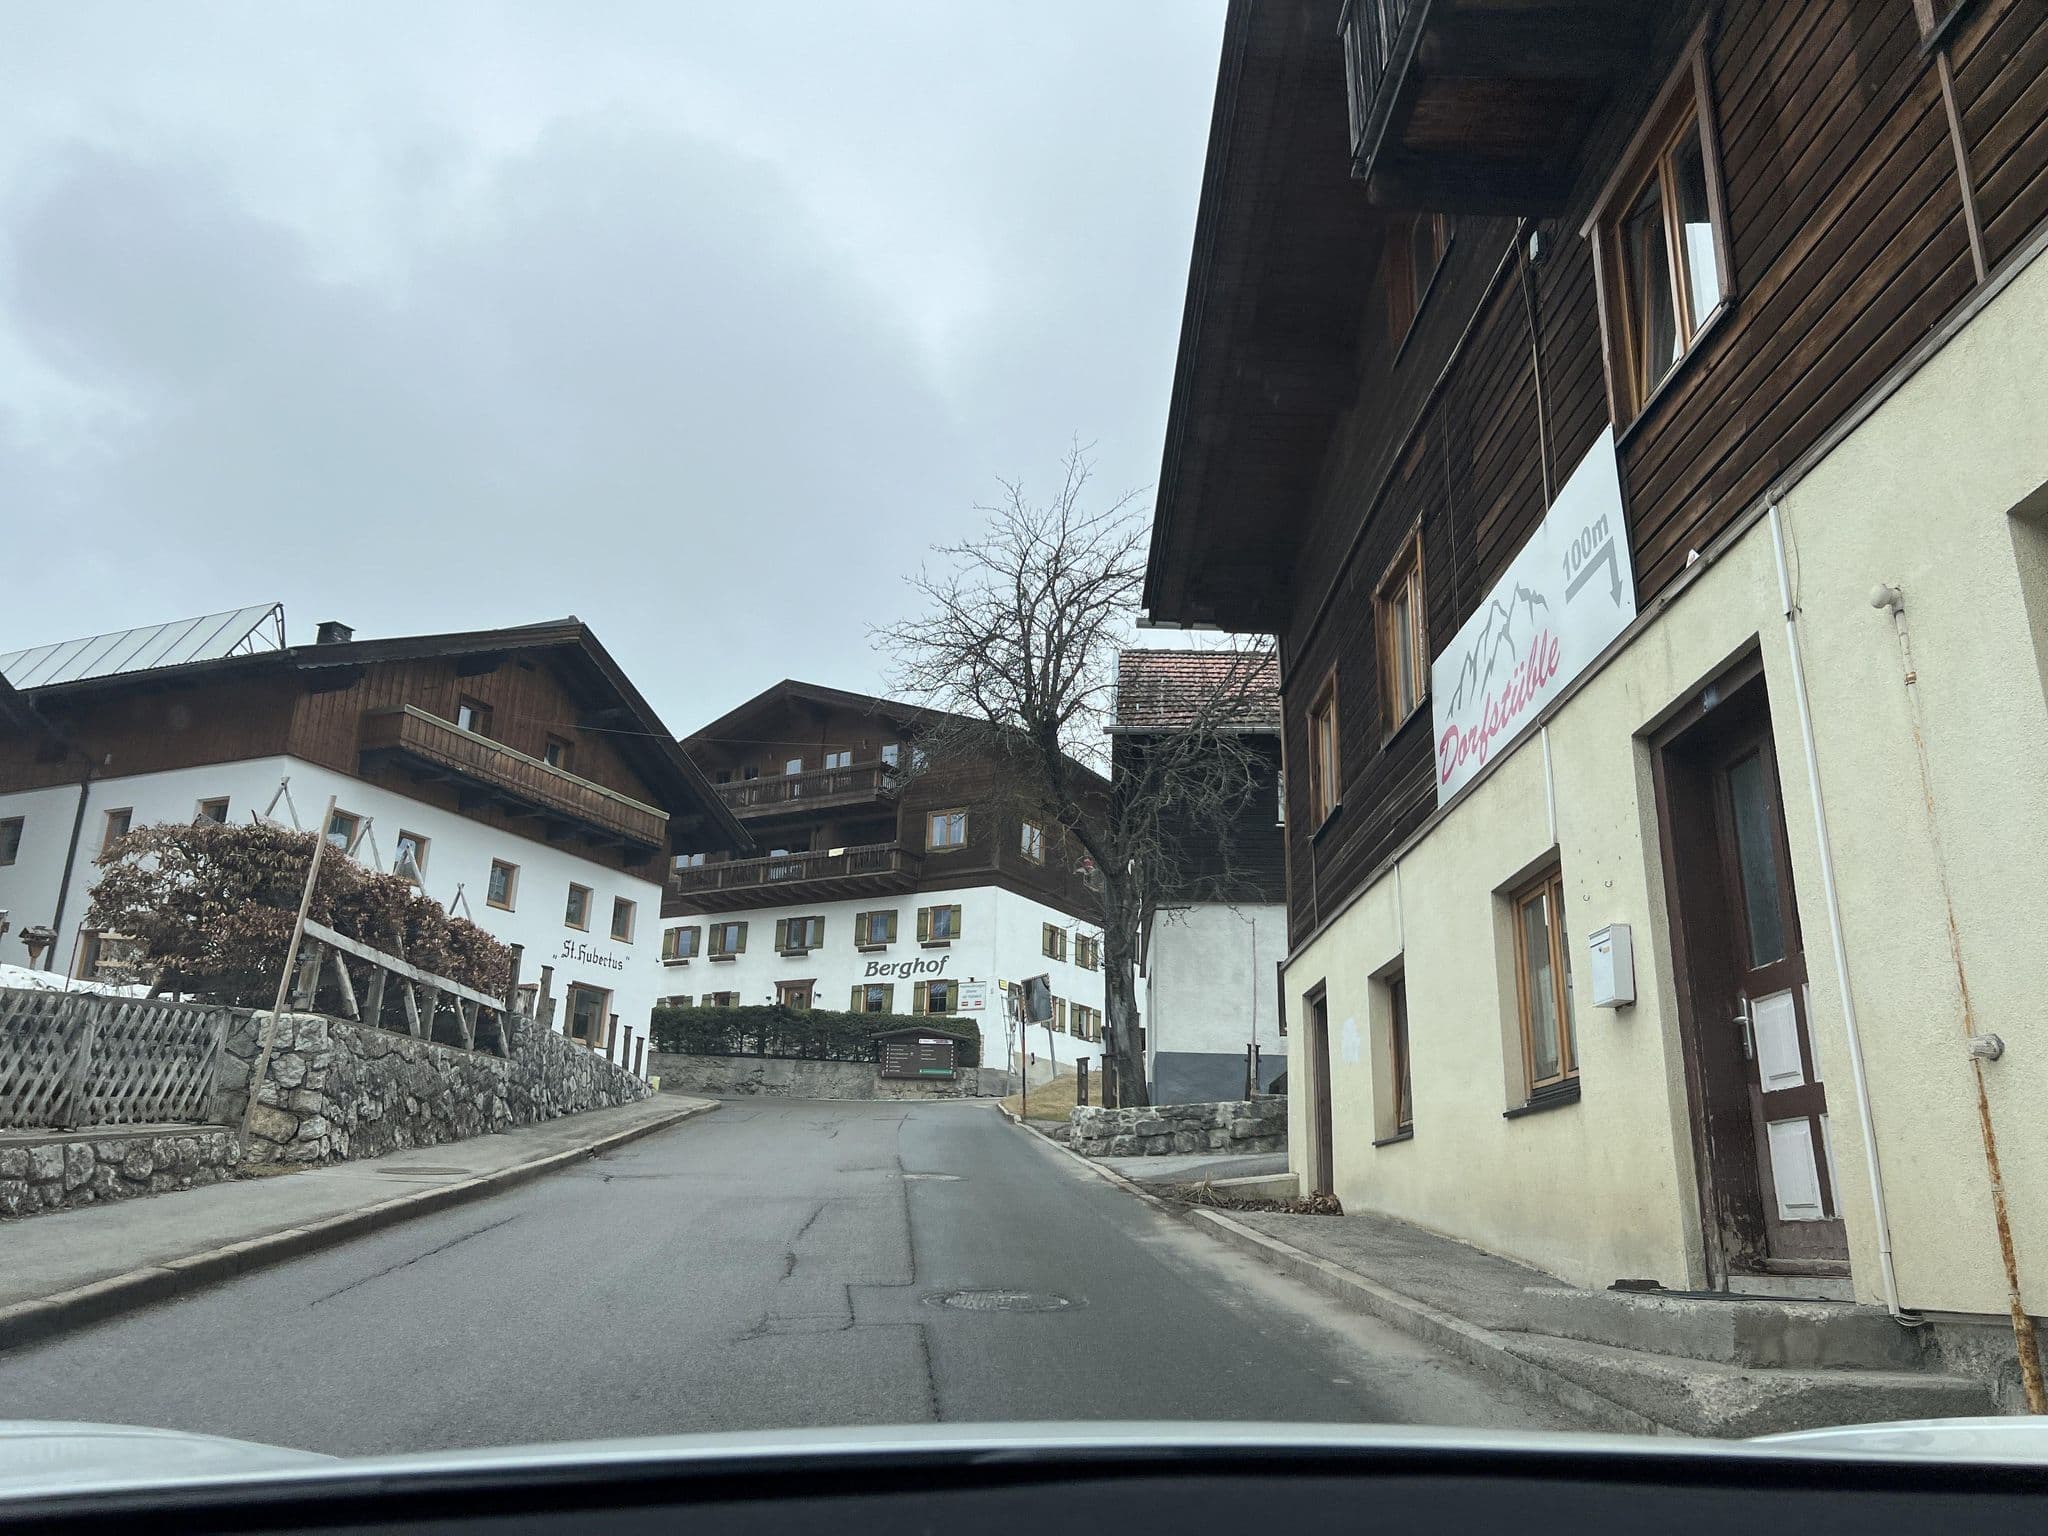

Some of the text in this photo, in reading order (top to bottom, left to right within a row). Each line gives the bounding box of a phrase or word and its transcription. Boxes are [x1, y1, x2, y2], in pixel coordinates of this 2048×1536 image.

[1562, 513, 1609, 580] 100m
[1439, 629, 1560, 785] Dorfstüble
[864, 955, 949, 979] Berghof
